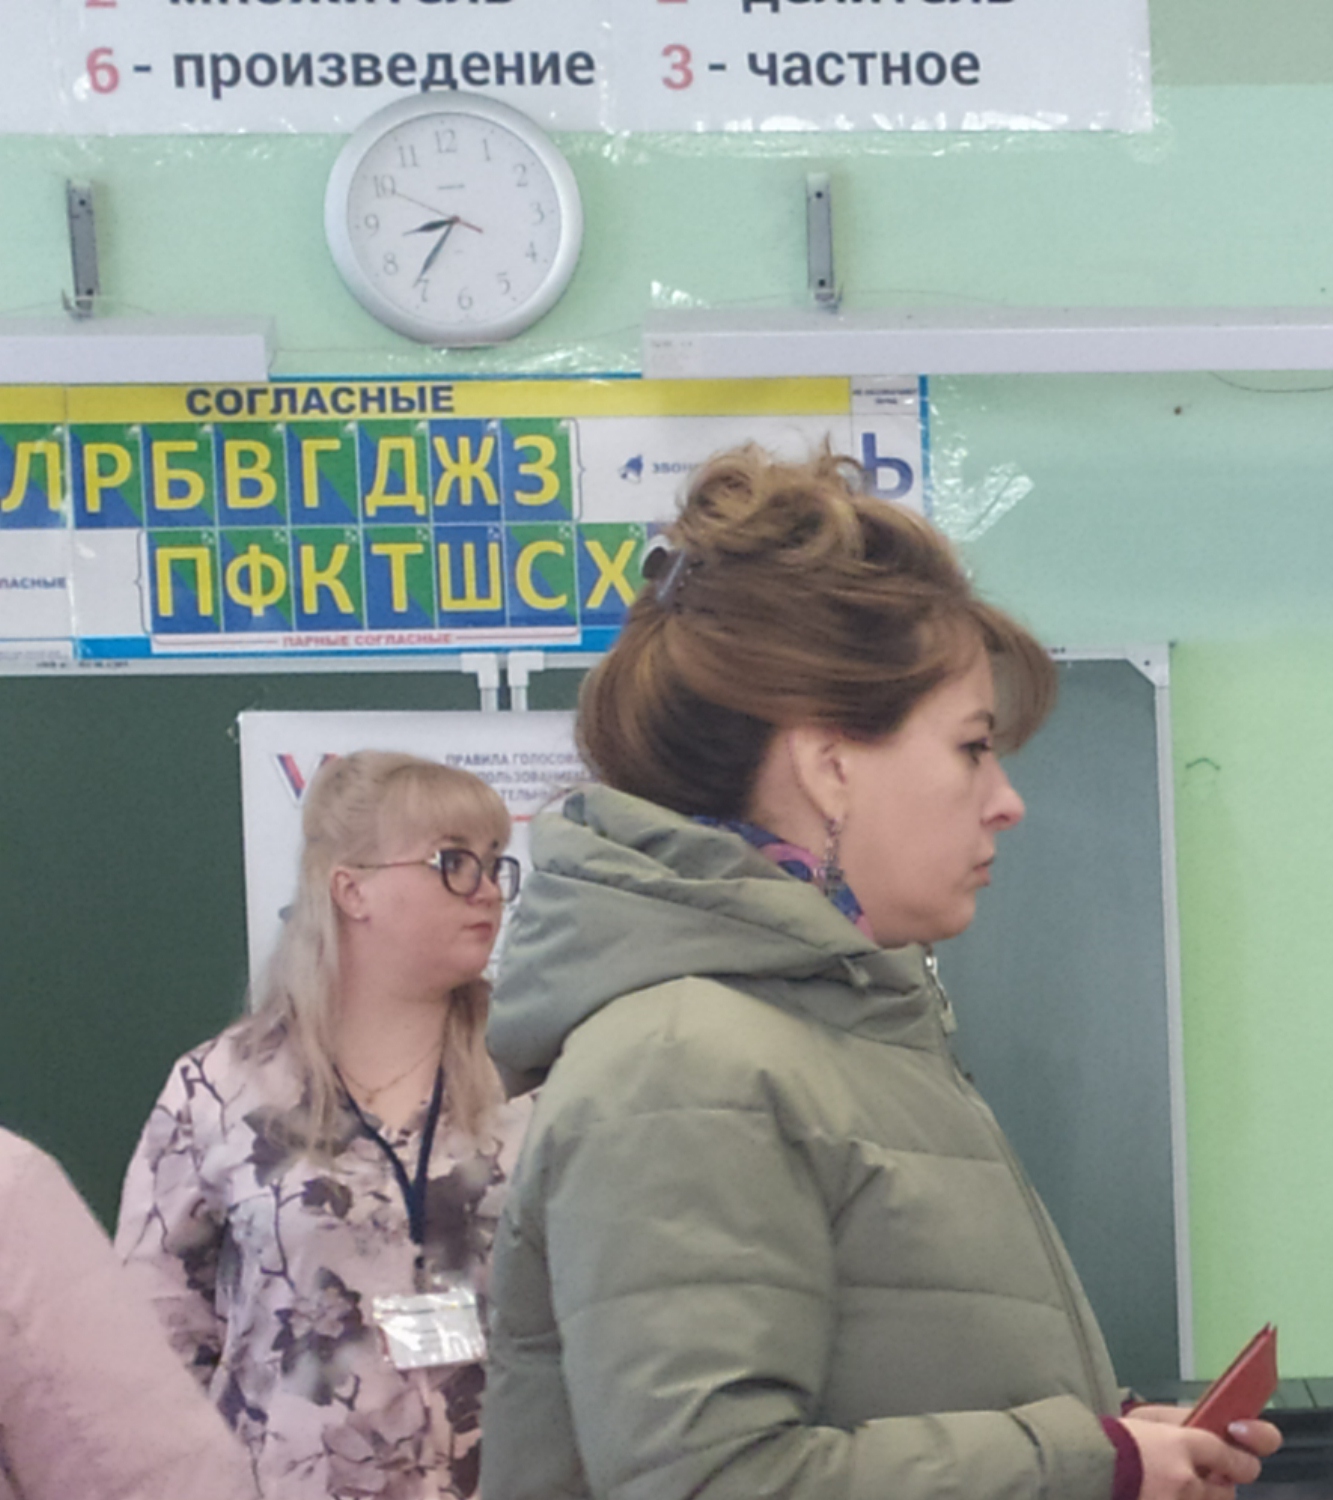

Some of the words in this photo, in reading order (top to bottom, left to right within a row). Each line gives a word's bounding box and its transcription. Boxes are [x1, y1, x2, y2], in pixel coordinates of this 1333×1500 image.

[86, 47, 120, 94] 6
[173, 50, 596, 98] произведение
[661, 44, 694, 90] 3
[747, 49, 981, 87] частное
[435, 129, 457, 153] 12
[483, 138, 491, 162] 1
[399, 145, 420, 168] 11
[374, 175, 397, 198] 10
[514, 163, 528, 187] 2
[530, 201, 545, 225] 3
[364, 214, 380, 237] 9
[383, 252, 398, 275] 8
[526, 241, 537, 262] 4
[497, 272, 511, 295] 5
[458, 286, 473, 310] 6
[186, 385, 455, 416] СОГЛАСНЫЕ
[0, 441, 63, 512] Л
[83, 442, 133, 512] Р
[152, 440, 205, 510] Б
[224, 439, 277, 509] В
[302, 438, 341, 508] Г
[365, 437, 426, 516] Д
[433, 436, 499, 506] Ж
[513, 435, 561, 506] З
[155, 546, 213, 617] П
[226, 543, 287, 617] Ф
[301, 543, 355, 614] К
[371, 543, 424, 612] Т
[438, 542, 502, 611] Ш
[515, 540, 567, 610] С
[585, 540, 637, 610] Х
[283, 635, 349, 647] ПАРНЫЕ
[354, 634, 451, 646] СОГЛАСНЫЕ
